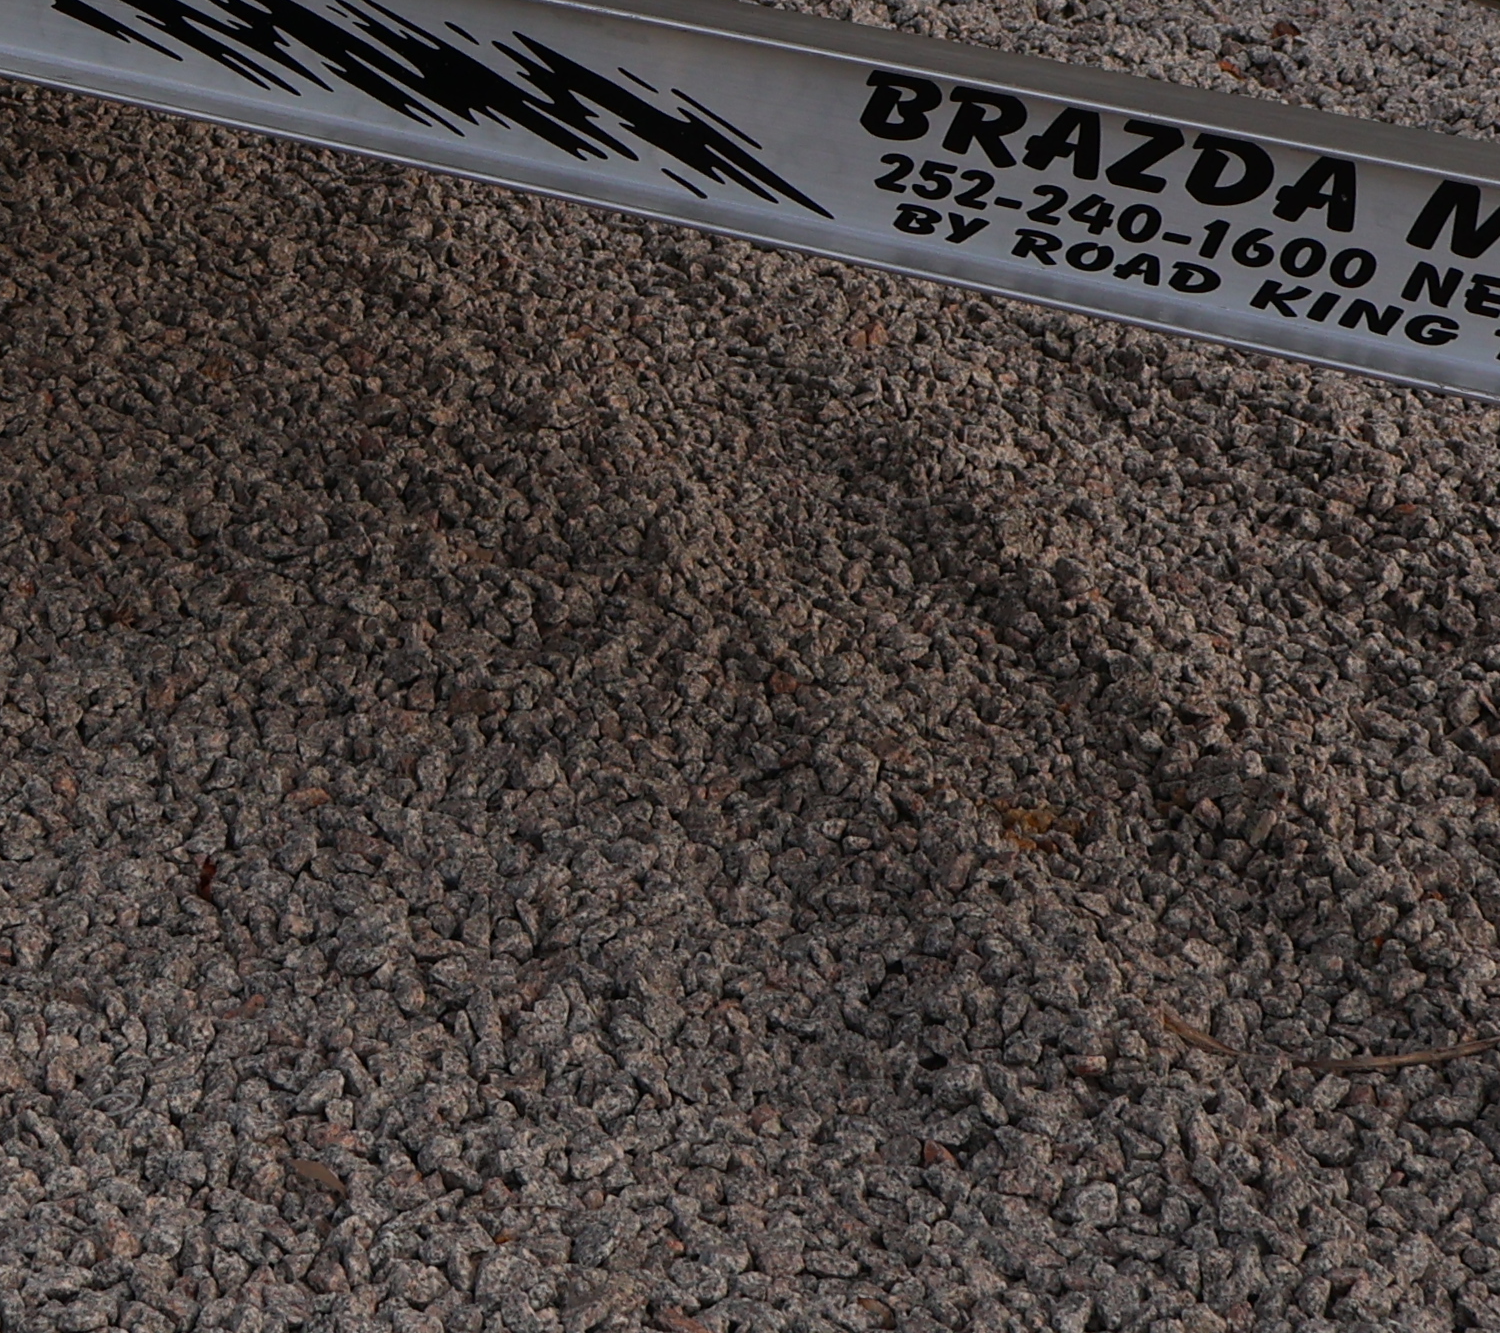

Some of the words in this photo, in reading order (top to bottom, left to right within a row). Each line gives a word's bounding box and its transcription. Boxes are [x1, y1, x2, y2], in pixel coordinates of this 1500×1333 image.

[859, 69, 1357, 234] BRAZDA
[873, 153, 1378, 289] 252-240-1600
[892, 202, 990, 244] BY
[1011, 228, 1222, 294] ROAD
[1249, 279, 1461, 346] KING
